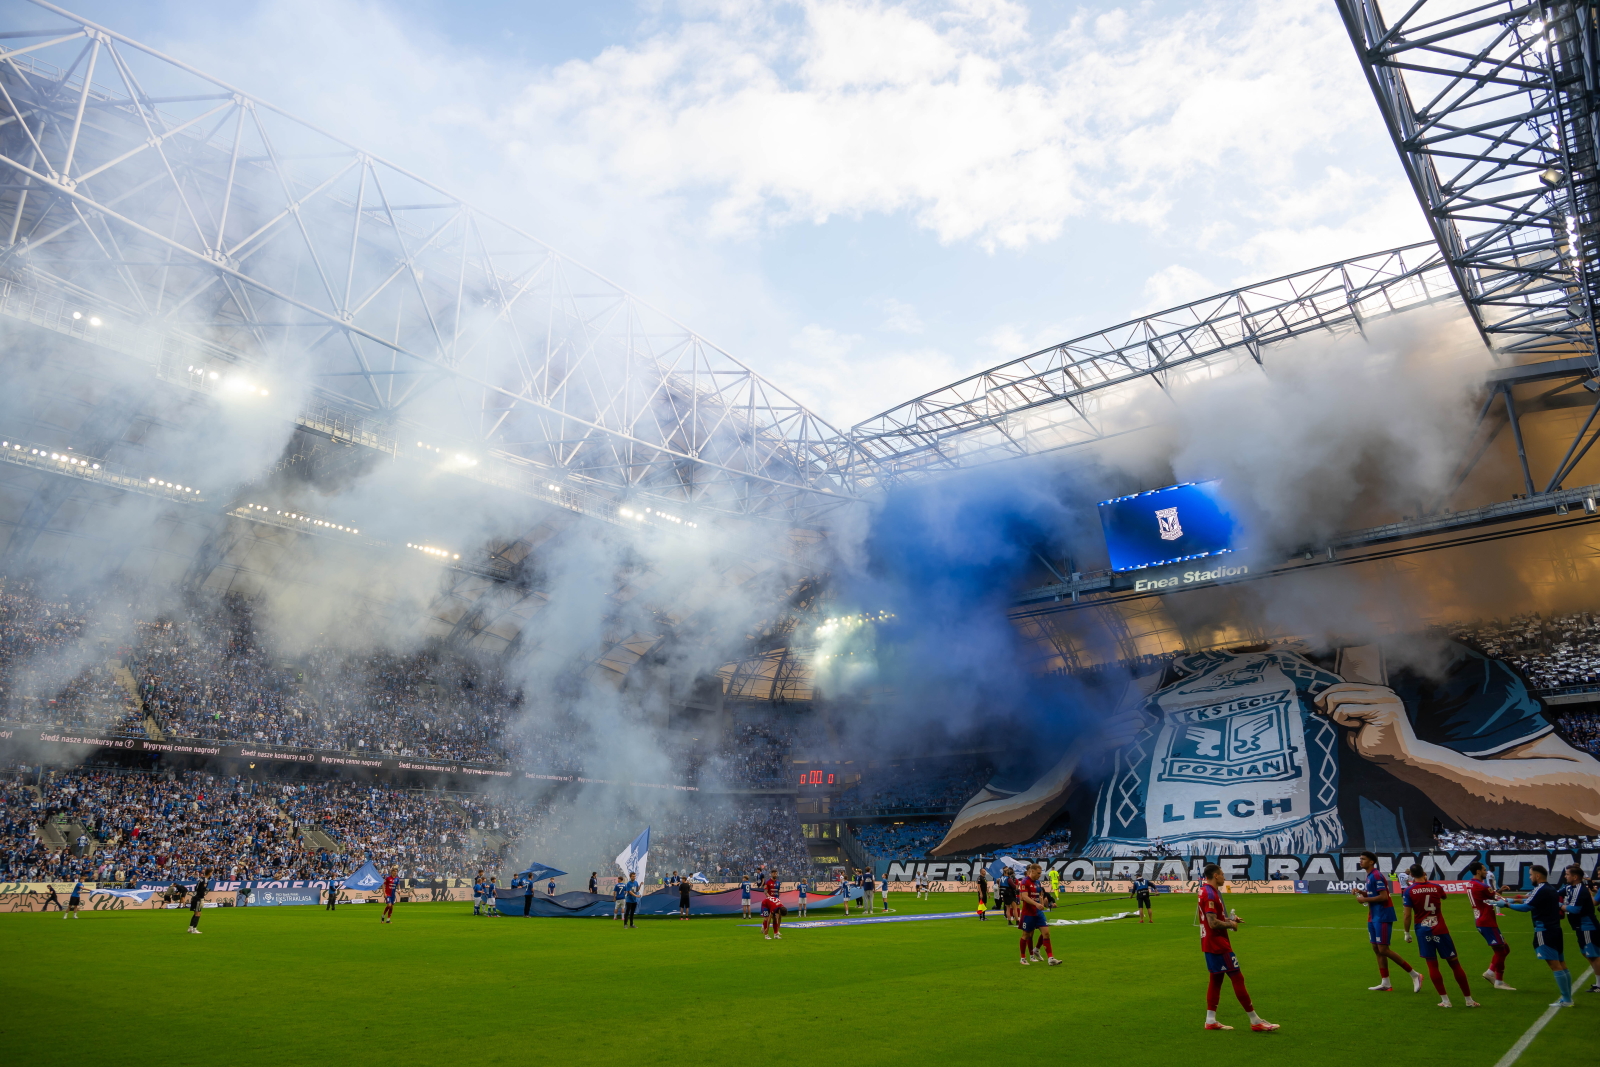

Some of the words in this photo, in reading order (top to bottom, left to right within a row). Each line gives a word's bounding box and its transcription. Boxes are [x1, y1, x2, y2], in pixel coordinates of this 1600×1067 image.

[1134, 576, 1179, 592] Enea
[1183, 565, 1249, 584] Stadion
[1183, 704, 1223, 721] KKS
[1228, 695, 1276, 712] LECH
[83, 737, 114, 747] konkursy
[143, 741, 174, 752] Wygrywaj
[194, 747, 220, 755] nagrody!
[800, 774, 806, 784] 0
[809, 770, 823, 784] 00
[828, 773, 834, 784] 0
[1163, 798, 1292, 823] LECH
[745, 884, 751, 893] 9
[929, 881, 946, 892] Pils
[1423, 894, 1437, 914] 4
